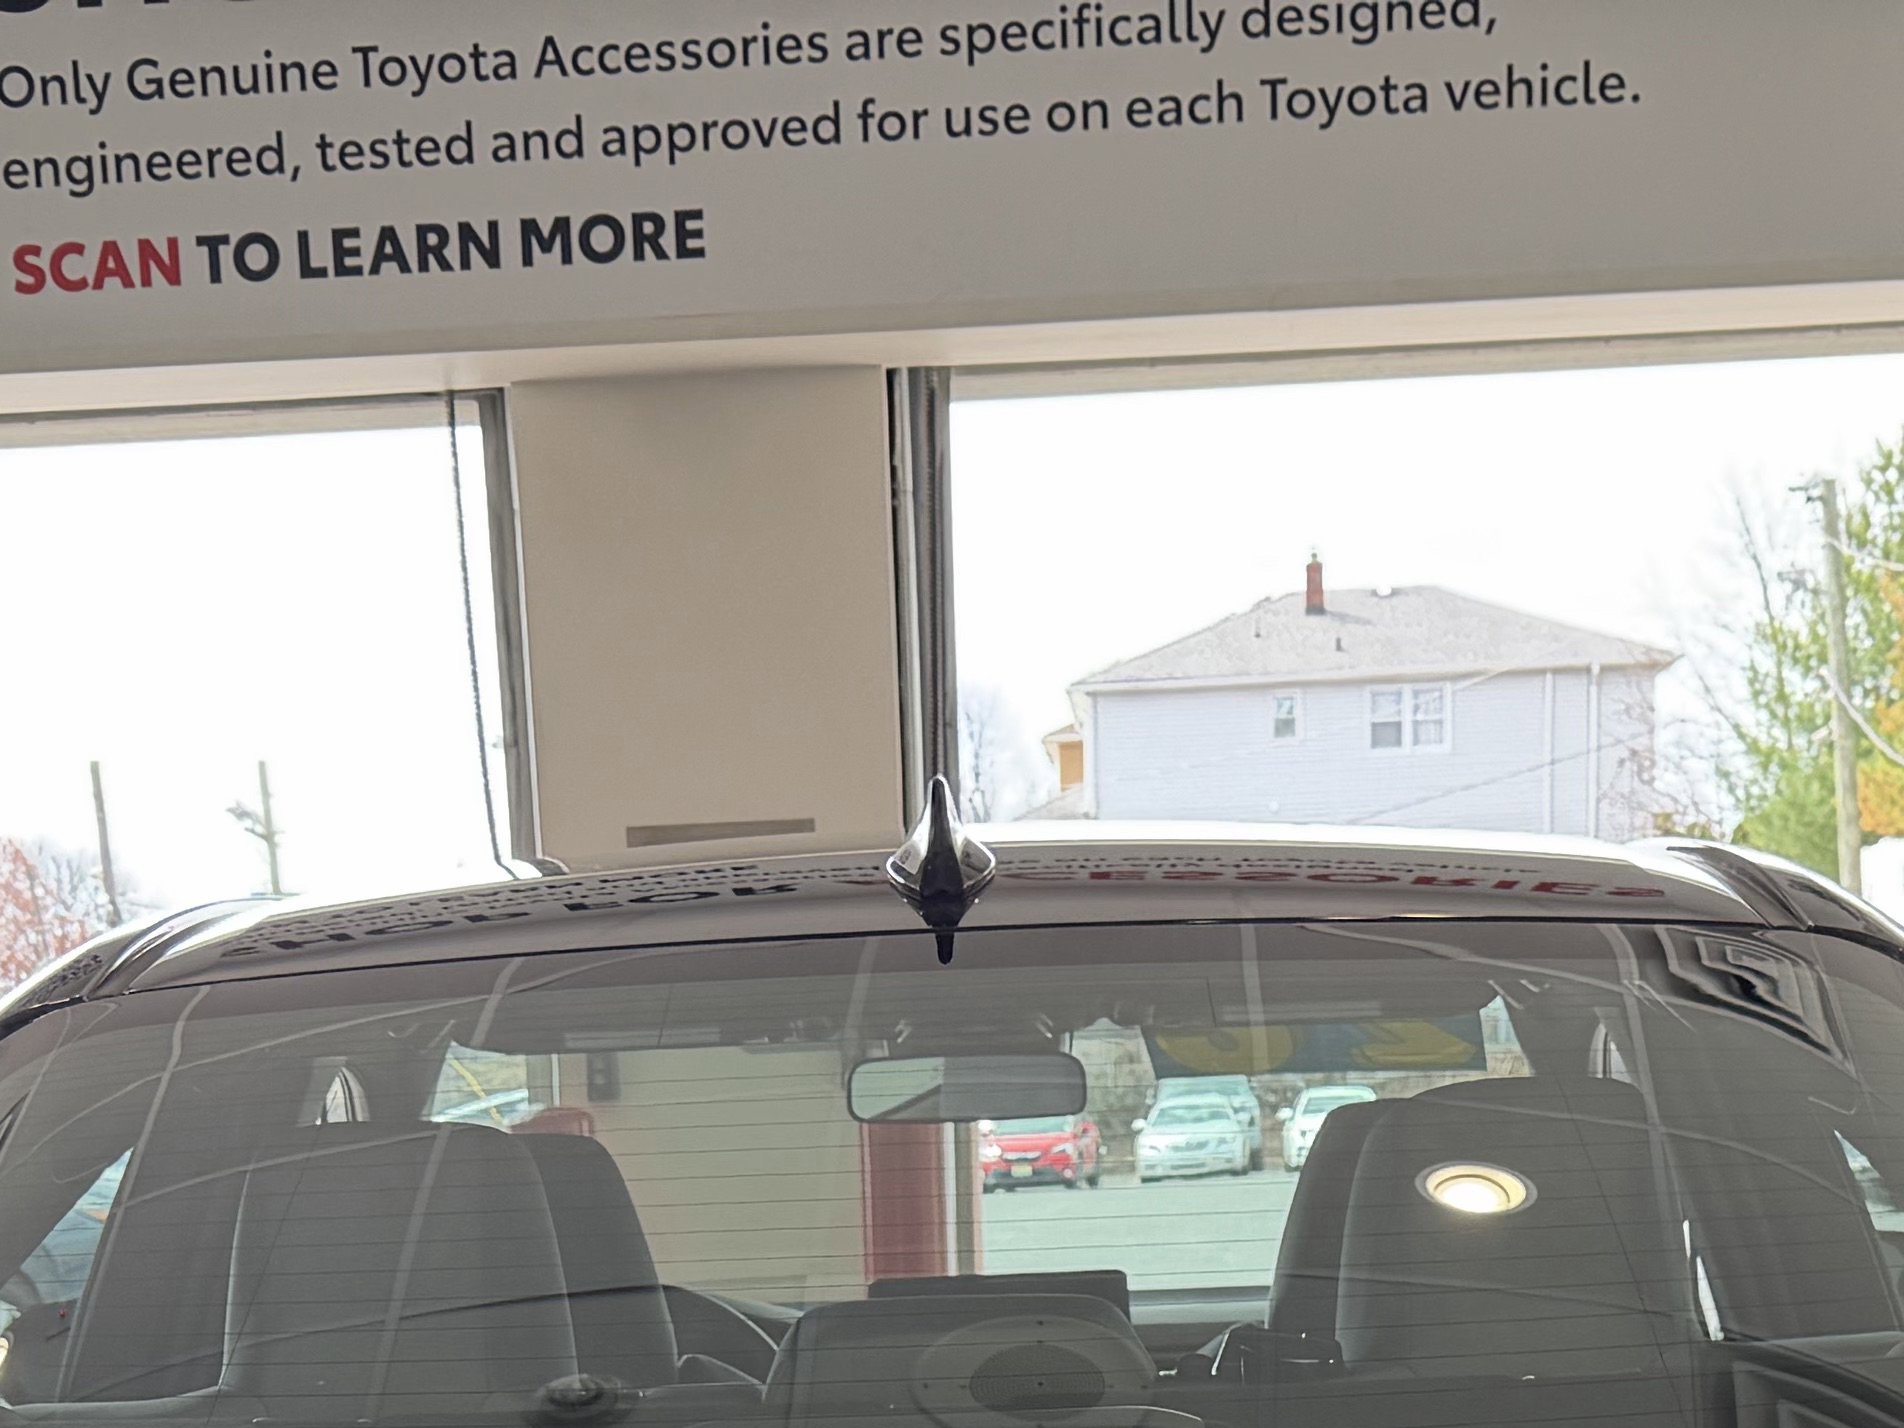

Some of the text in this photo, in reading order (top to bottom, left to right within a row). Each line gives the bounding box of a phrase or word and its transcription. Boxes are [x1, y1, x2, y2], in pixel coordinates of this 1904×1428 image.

[127, 49, 339, 101] Genuine
[352, 42, 518, 97] Toyota
[534, 22, 829, 79] Accessories
[845, 26, 924, 61] are
[939, 1, 1226, 67] specifically
[1241, 0, 1497, 46] designed,
[2, 59, 1642, 198] engineered, tested and approved for use on each Toyota vehicle.
[12, 210, 706, 295] SCAN TO LEARN MORE
